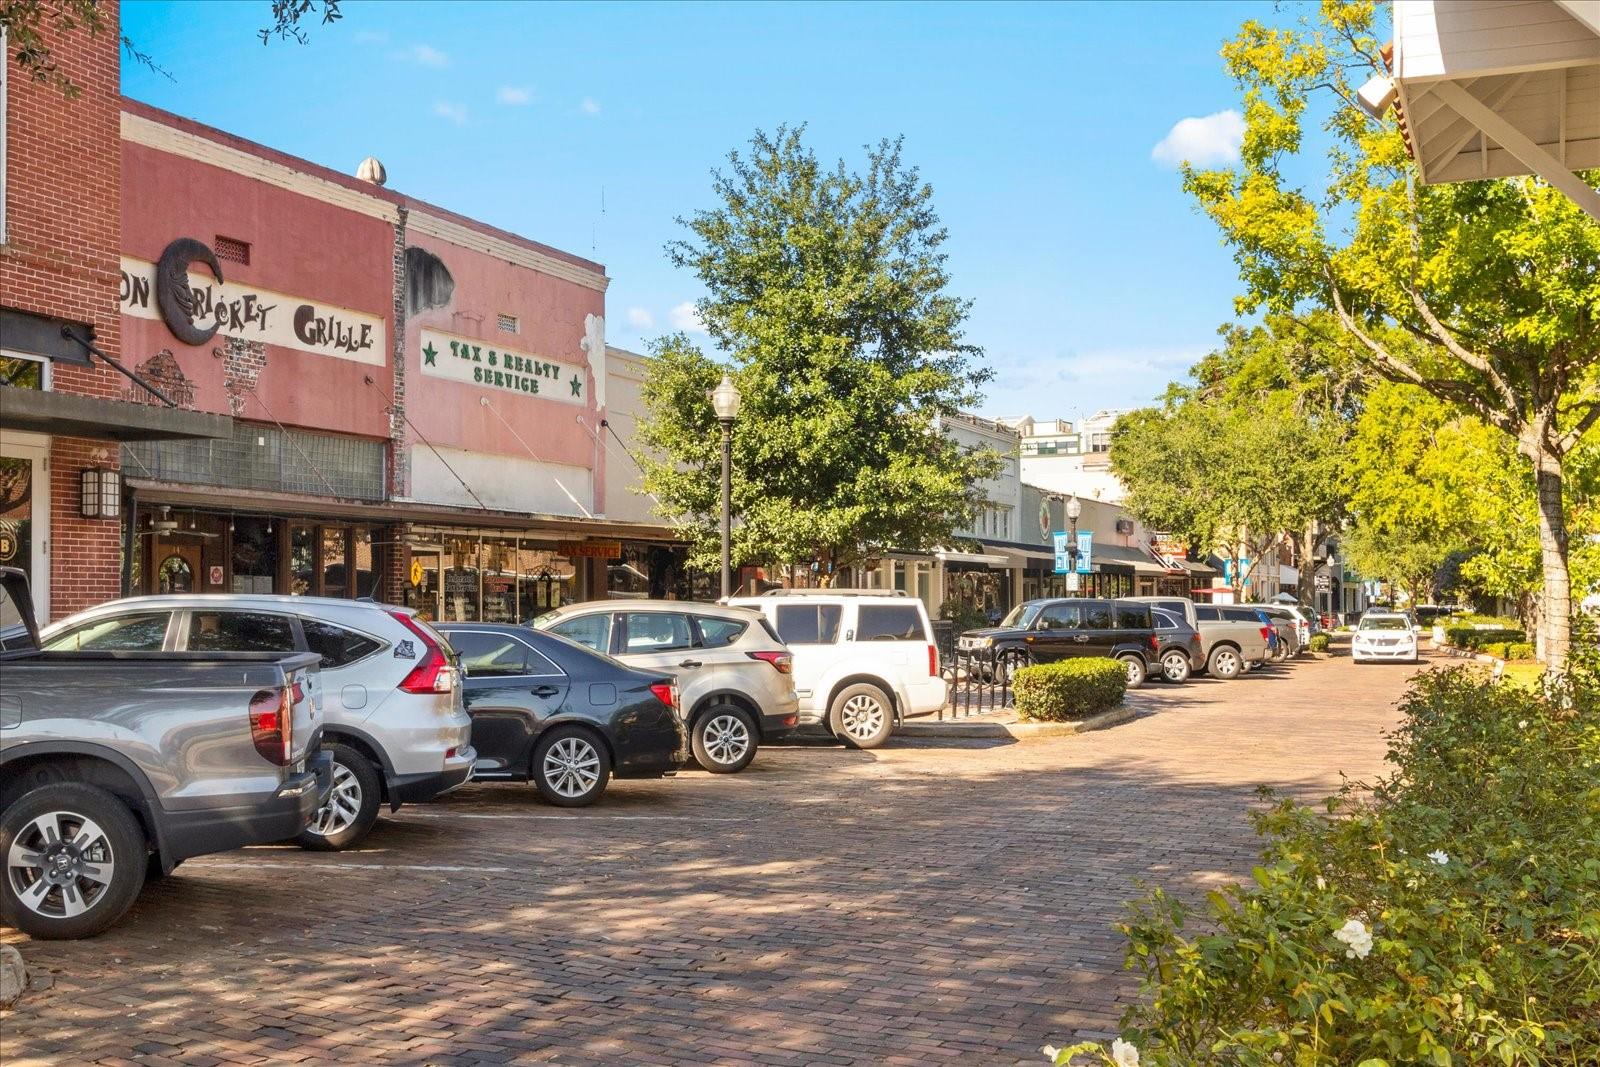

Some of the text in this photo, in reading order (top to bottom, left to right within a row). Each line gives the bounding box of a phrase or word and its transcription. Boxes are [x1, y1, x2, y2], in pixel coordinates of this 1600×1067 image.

[293, 304, 374, 353] GRILLE
[450, 340, 561, 380] TAX & REALTY
[473, 366, 539, 395] SERVICE
